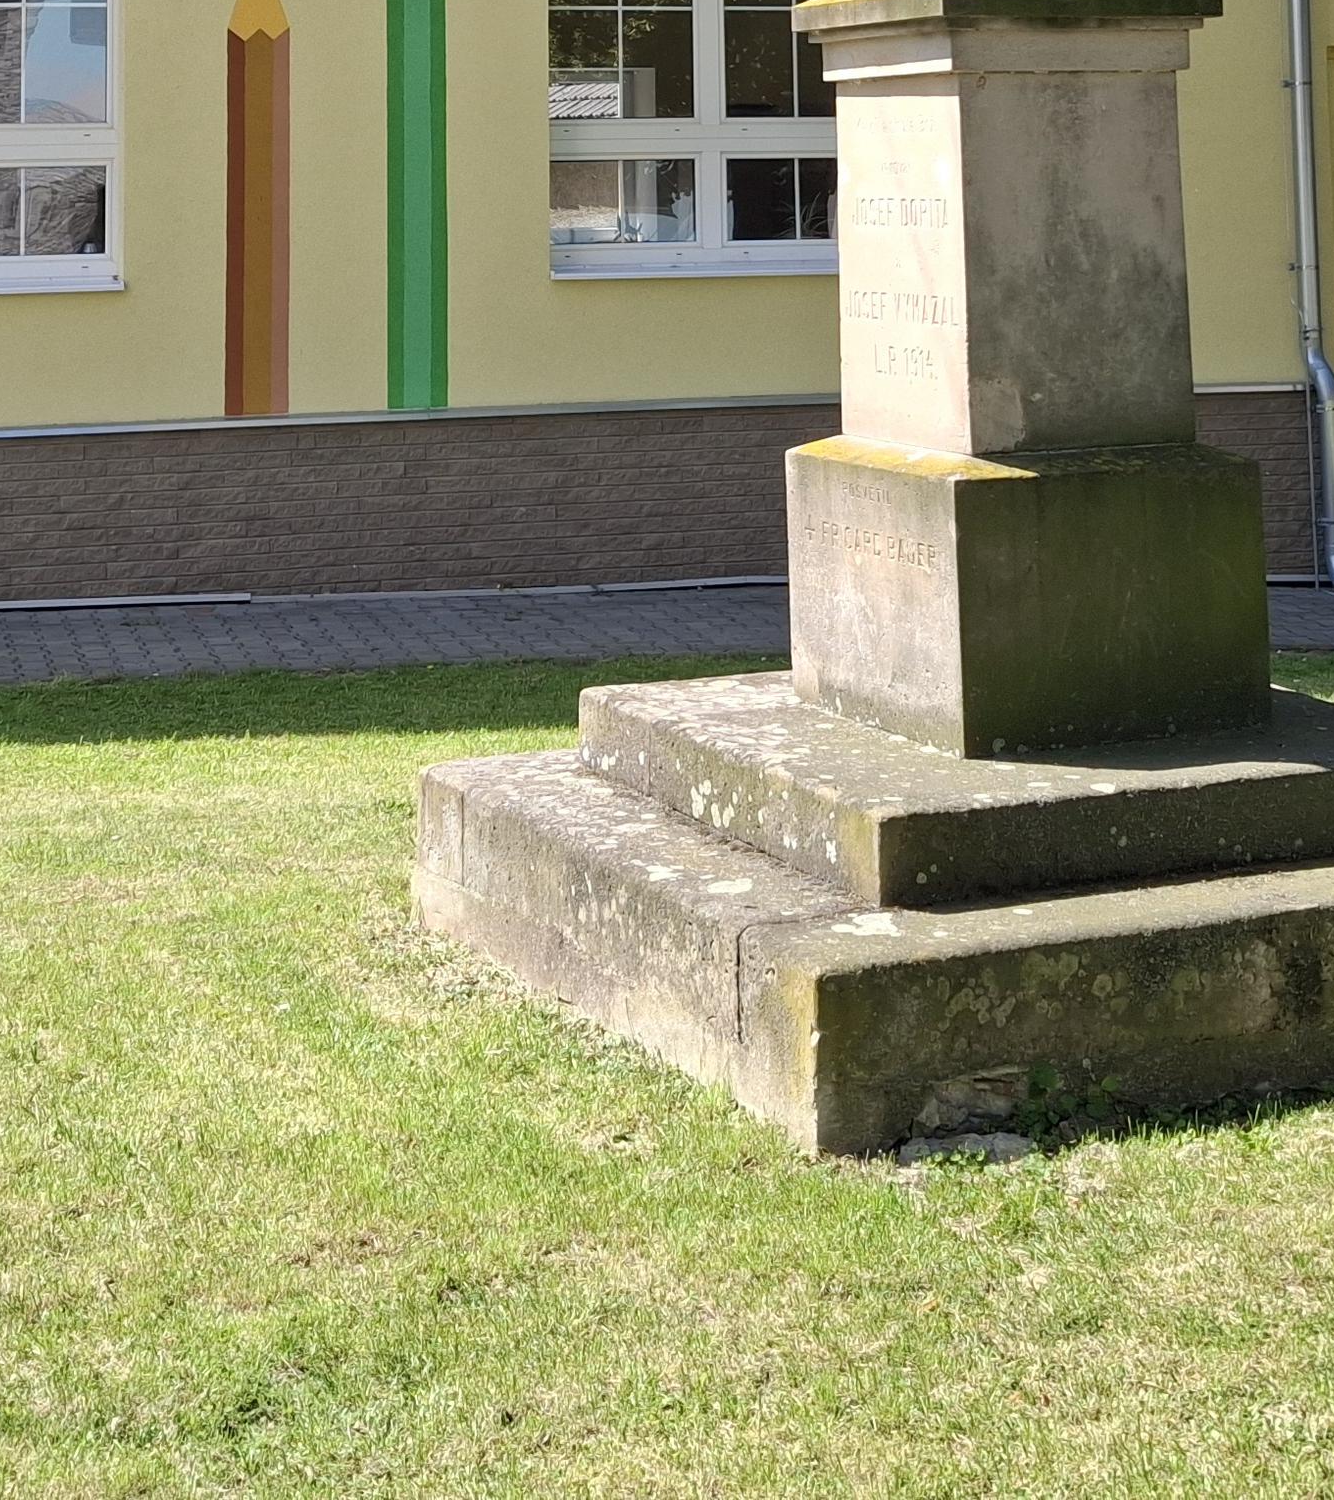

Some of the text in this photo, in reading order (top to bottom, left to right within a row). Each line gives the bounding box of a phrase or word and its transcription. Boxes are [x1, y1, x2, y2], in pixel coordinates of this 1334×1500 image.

[852, 197, 949, 229] JOSEF DOPITA
[845, 290, 959, 326] JOSEF VYMAZAL
